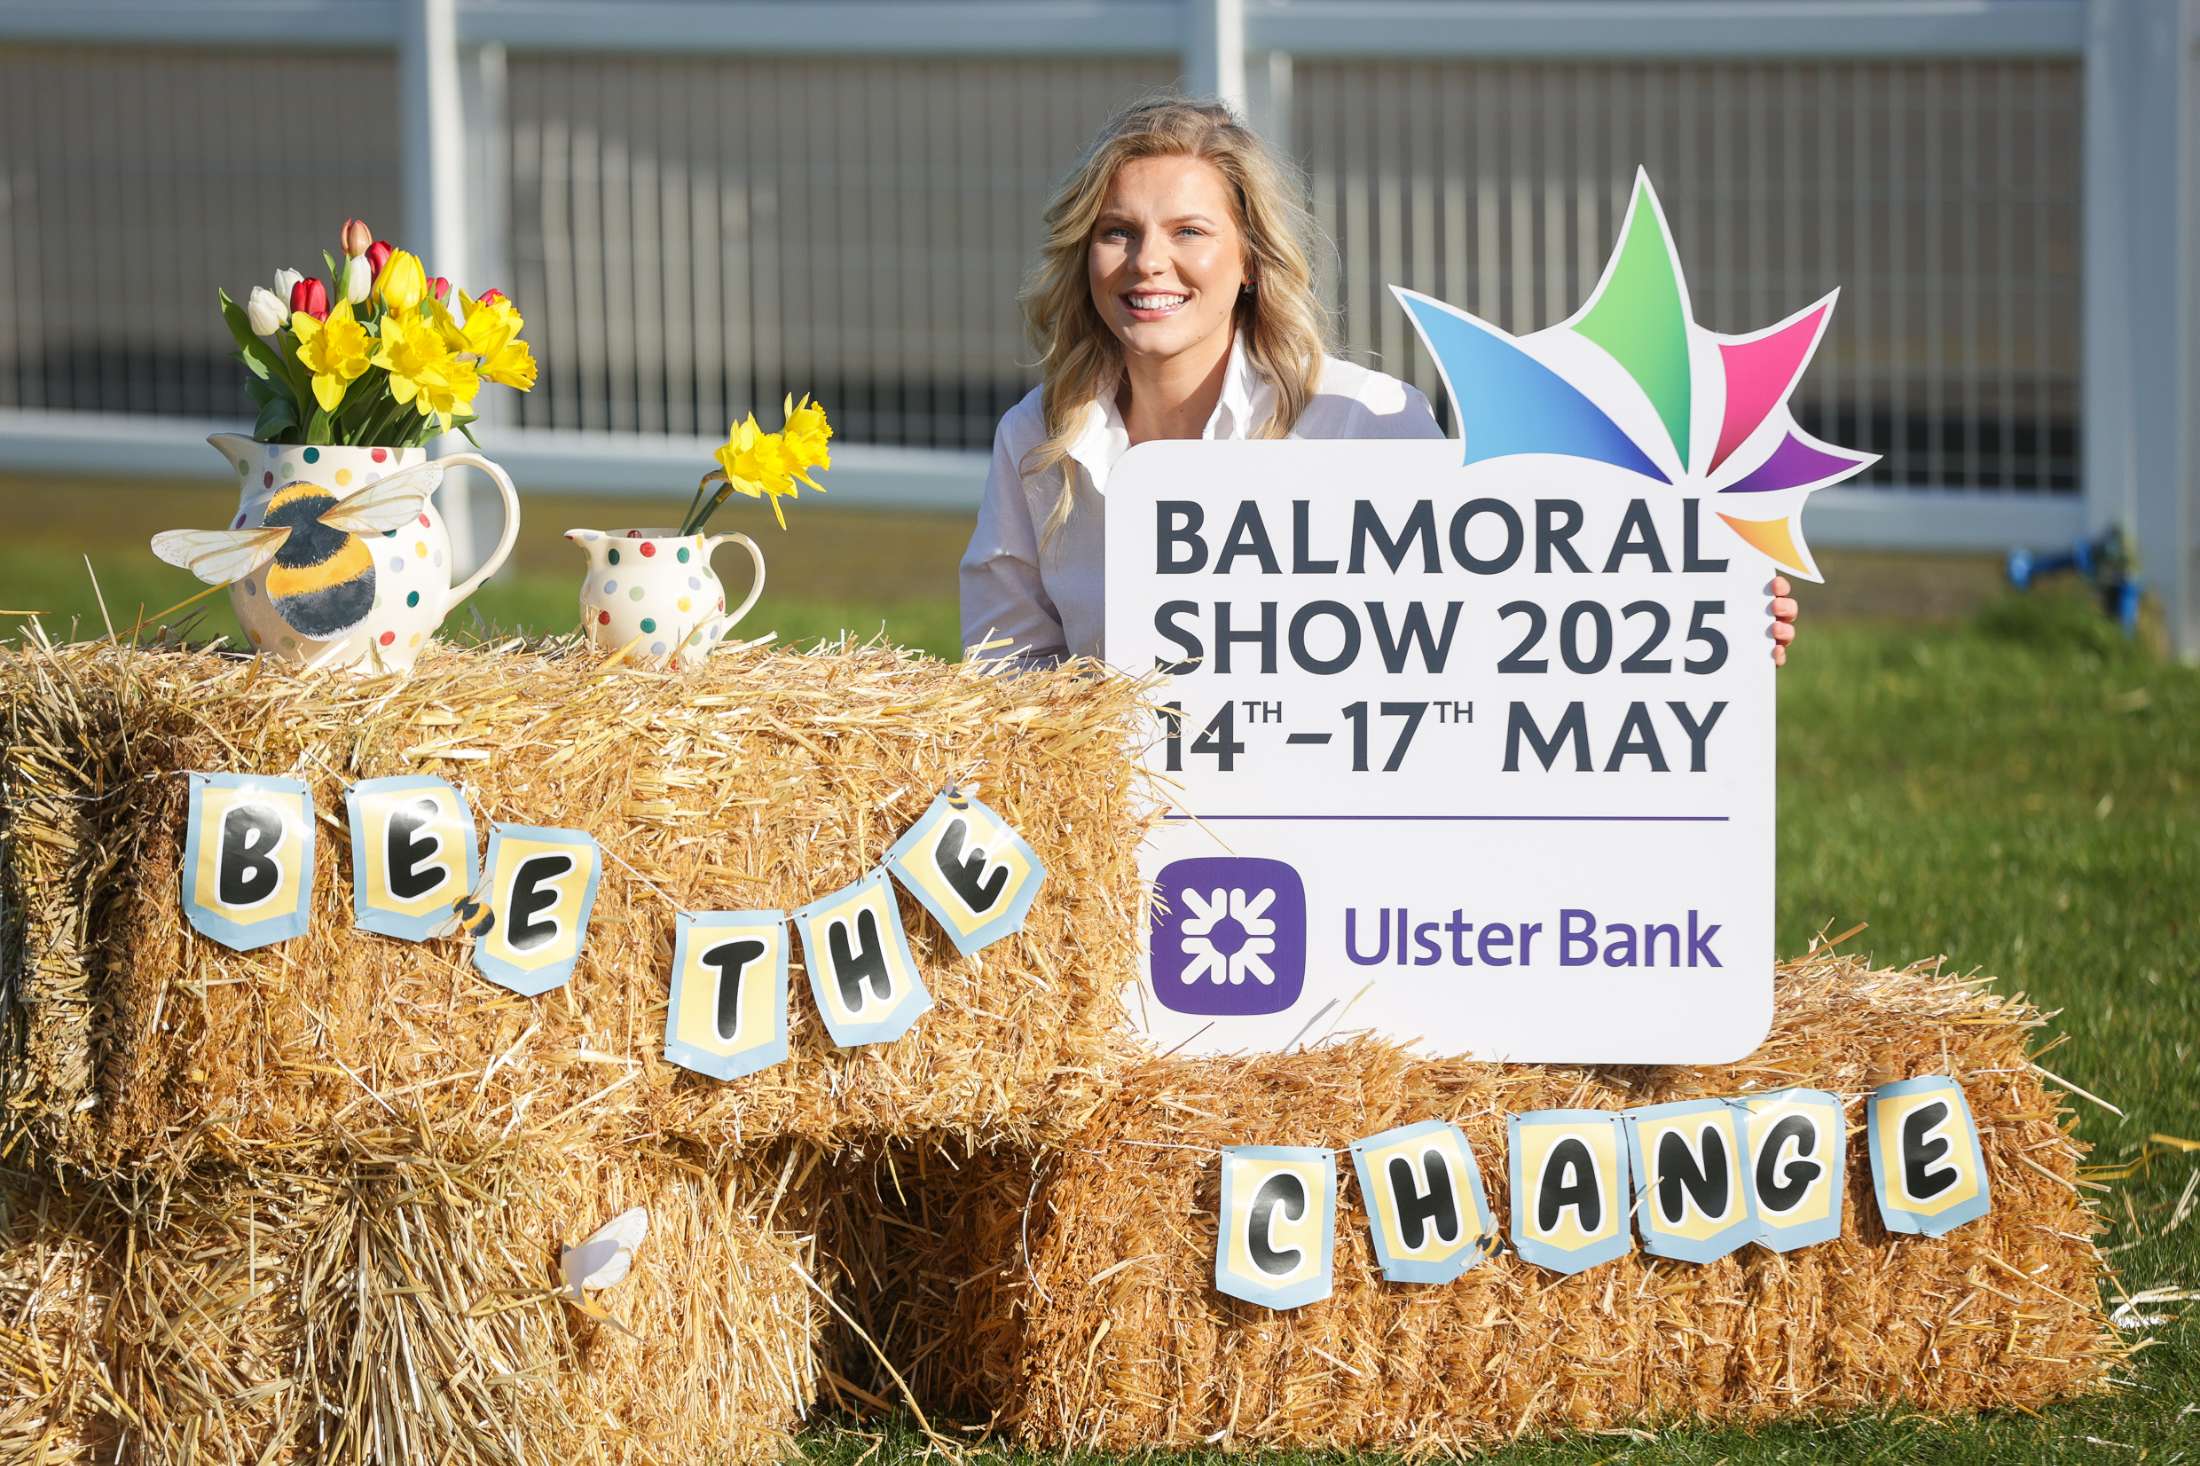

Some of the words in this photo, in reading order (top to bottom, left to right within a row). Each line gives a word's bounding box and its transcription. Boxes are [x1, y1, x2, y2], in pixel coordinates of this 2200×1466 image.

[1155, 497, 1730, 575] BALMORAL
[1153, 599, 1464, 676] SHOW
[1496, 599, 1729, 675] 2025
[1501, 700, 1730, 773] MAY
[218, 798, 573, 951] BEE
[701, 817, 1010, 1040] THE
[1344, 906, 1543, 968] Ulster
[1559, 908, 1724, 968] Bank
[1247, 1101, 1960, 1276] CHANGE
